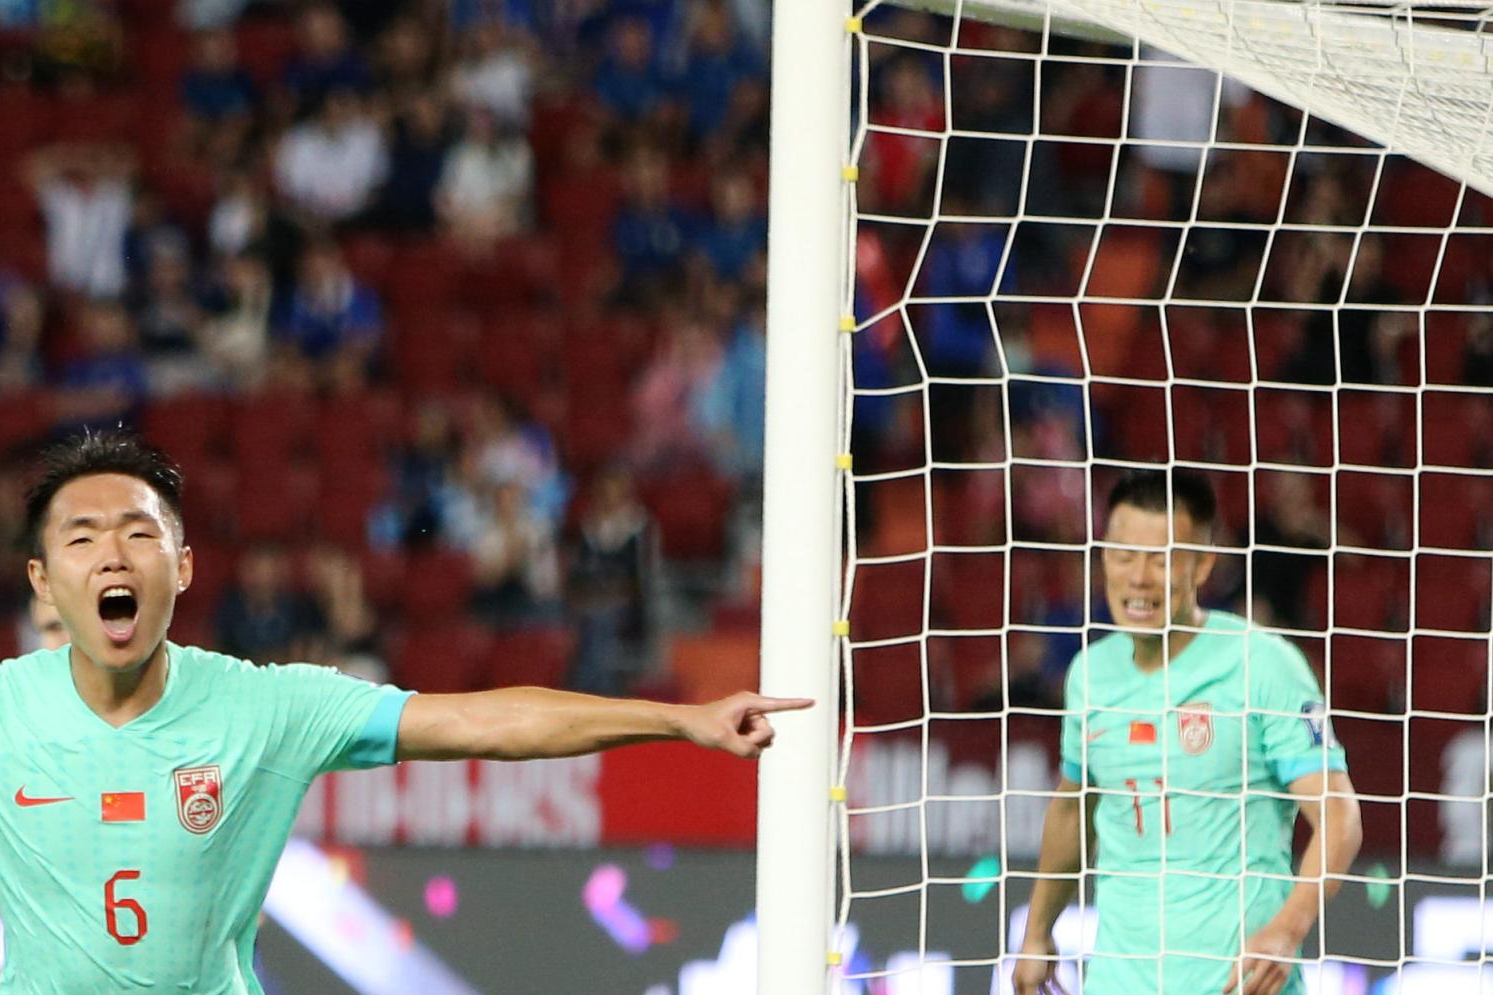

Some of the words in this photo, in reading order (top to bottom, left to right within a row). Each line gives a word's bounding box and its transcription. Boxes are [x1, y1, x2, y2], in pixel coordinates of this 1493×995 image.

[179, 771, 217, 787] CFA
[1124, 776, 1173, 838] 11
[104, 869, 148, 945] 6
